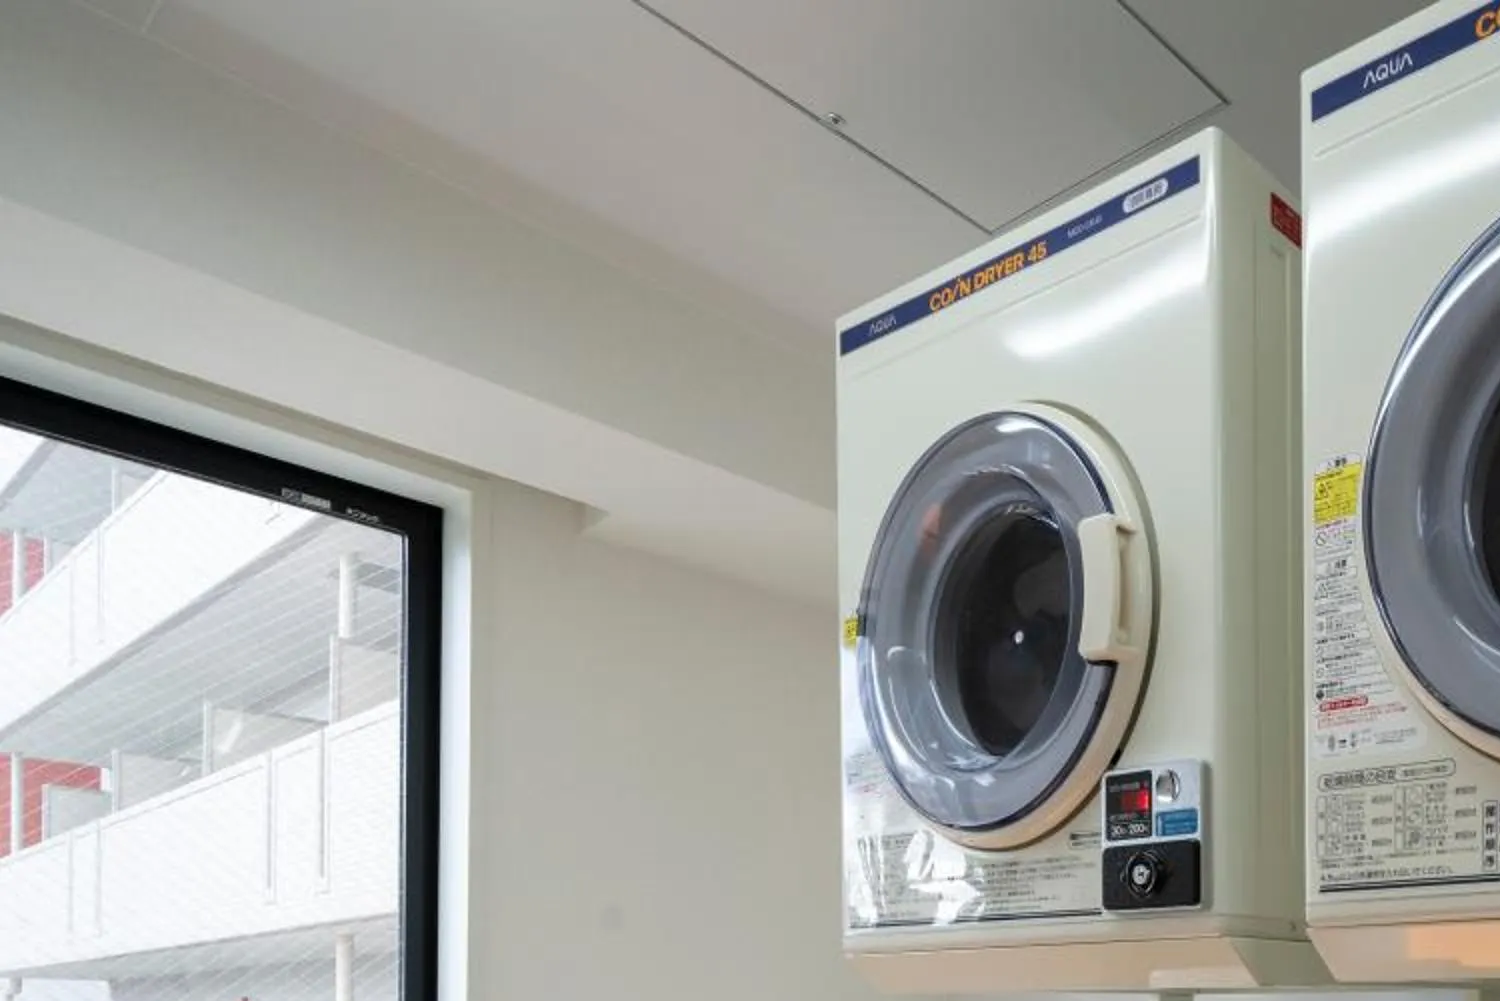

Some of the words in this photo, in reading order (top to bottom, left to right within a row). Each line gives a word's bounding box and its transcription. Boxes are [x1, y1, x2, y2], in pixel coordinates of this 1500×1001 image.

[1363, 53, 1413, 88] AQUA
[869, 314, 897, 336] AQUA
[974, 252, 1025, 290] DRYER
